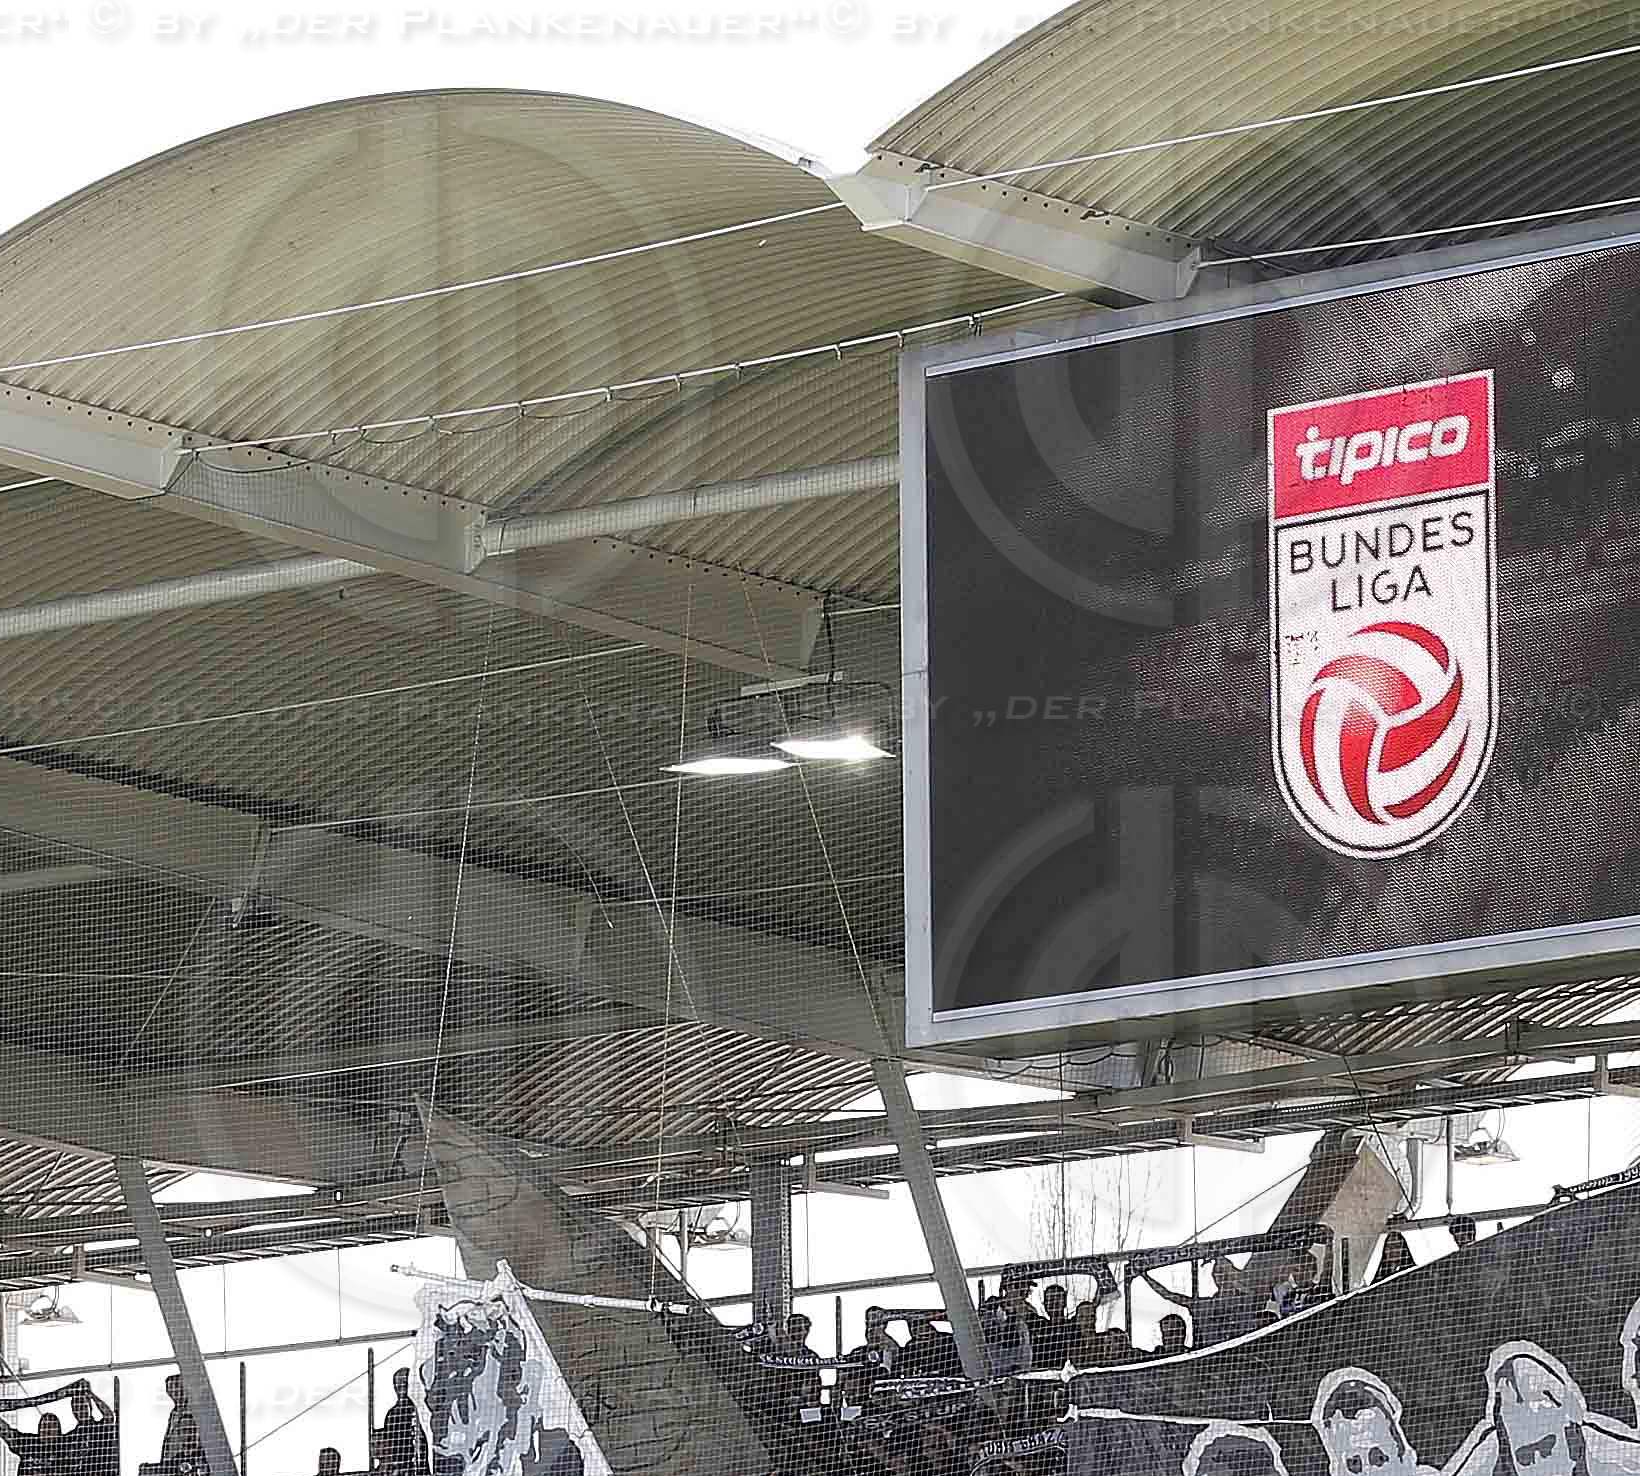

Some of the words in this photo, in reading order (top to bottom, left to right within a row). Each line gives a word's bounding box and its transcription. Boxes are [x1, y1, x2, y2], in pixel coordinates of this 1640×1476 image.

[1292, 408, 1472, 484] tipico
[1288, 512, 1476, 577] BUNDES
[1328, 564, 1433, 615] LIGA
